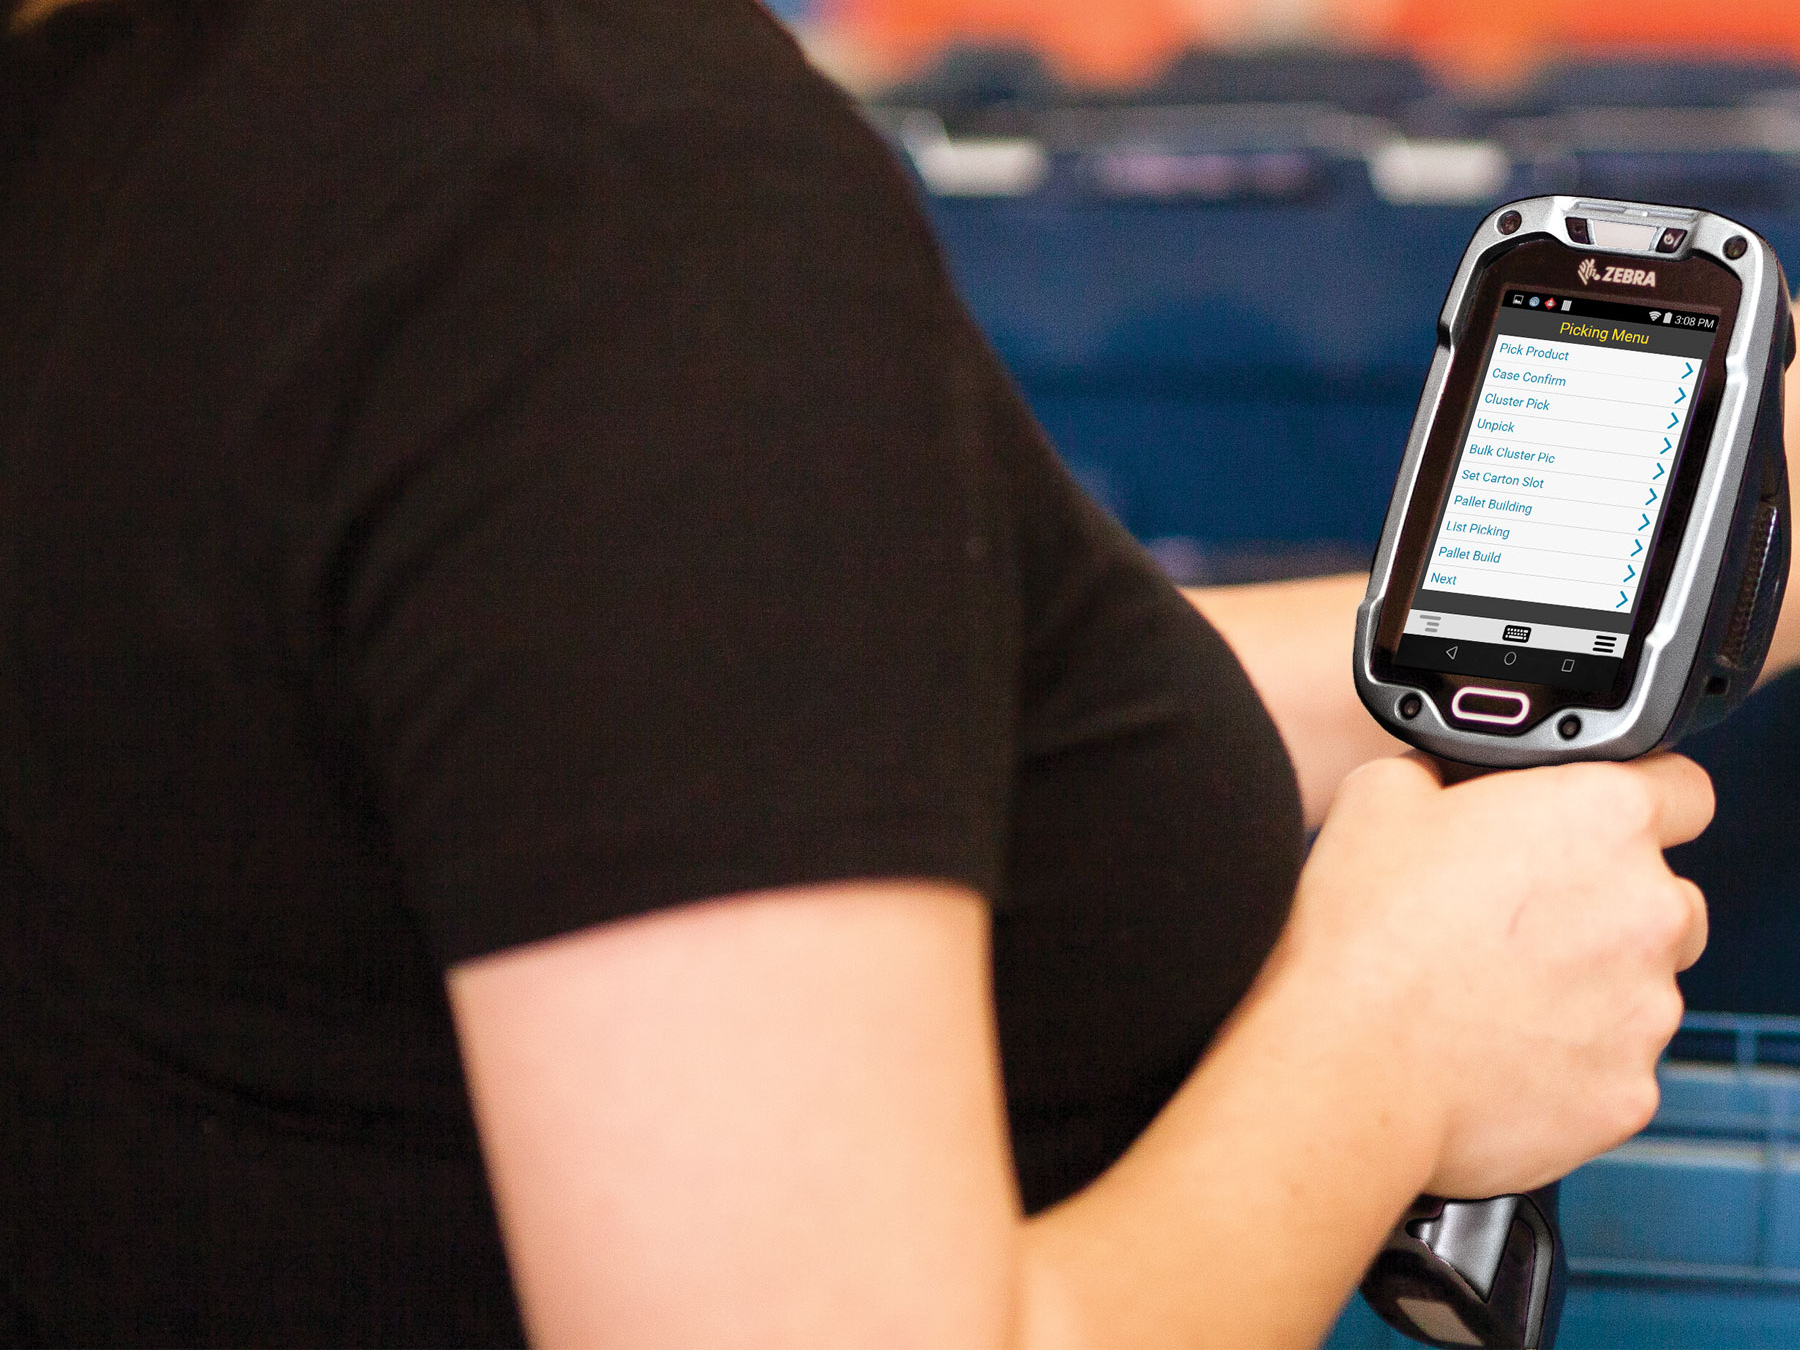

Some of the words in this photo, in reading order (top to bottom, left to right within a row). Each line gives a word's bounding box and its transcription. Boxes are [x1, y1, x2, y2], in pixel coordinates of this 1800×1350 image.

[1602, 267, 1655, 287] ZEBRA
[1674, 316, 1696, 326] 3:08
[1697, 319, 1715, 329] PM
[1559, 322, 1609, 343] Picking
[1611, 328, 1650, 345] Menu
[1499, 343, 1524, 355] Pick
[1525, 346, 1569, 362] Product
[1492, 368, 1521, 381] Case
[1522, 372, 1567, 387] Confirm
[1485, 394, 1524, 407] Cluster
[1525, 398, 1550, 411] Pick
[1477, 418, 1515, 434] Unpick
[1469, 444, 1494, 457] Bulk
[1496, 448, 1536, 462] Cluster
[1537, 452, 1555, 464] Pic
[1461, 470, 1481, 482] Set
[1482, 473, 1520, 486] Carton
[1522, 477, 1545, 489] Slot
[1453, 495, 1486, 508] Pallet
[1488, 499, 1533, 517] Building
[1446, 522, 1468, 532] List
[1469, 524, 1511, 541] Picking
[1437, 547, 1471, 561] Pallet
[1472, 550, 1502, 564] Build
[1430, 572, 1457, 586] Next
